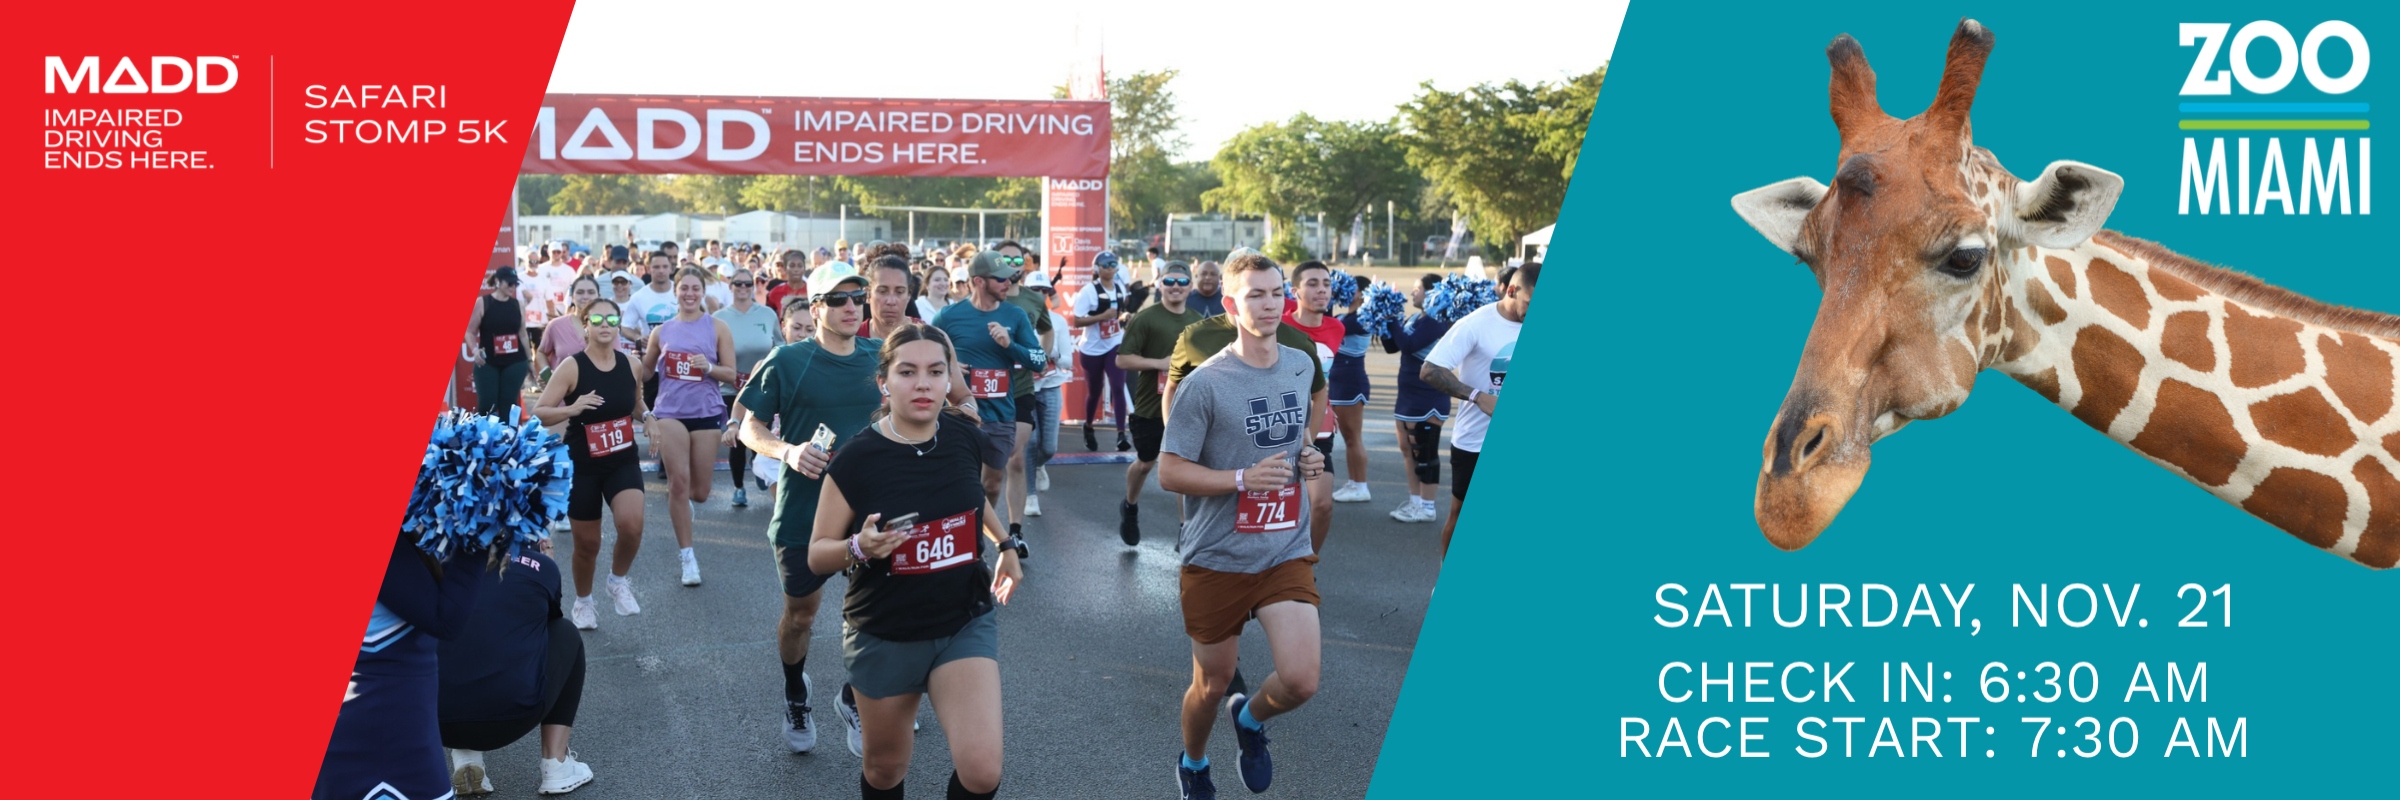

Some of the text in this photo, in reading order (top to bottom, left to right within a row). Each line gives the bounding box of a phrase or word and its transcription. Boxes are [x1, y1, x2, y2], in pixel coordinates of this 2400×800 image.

[795, 110, 1093, 136] IMPAIRED DRIVING
[794, 141, 987, 165] ENDS HERE.
[1051, 179, 1103, 191] MADD
[503, 340, 512, 350] 48
[676, 361, 690, 375] 69
[984, 379, 998, 392] 30
[1245, 407, 1303, 435] STATE
[600, 430, 624, 448] 119
[1256, 501, 1285, 523] 774
[917, 534, 954, 563] 646
